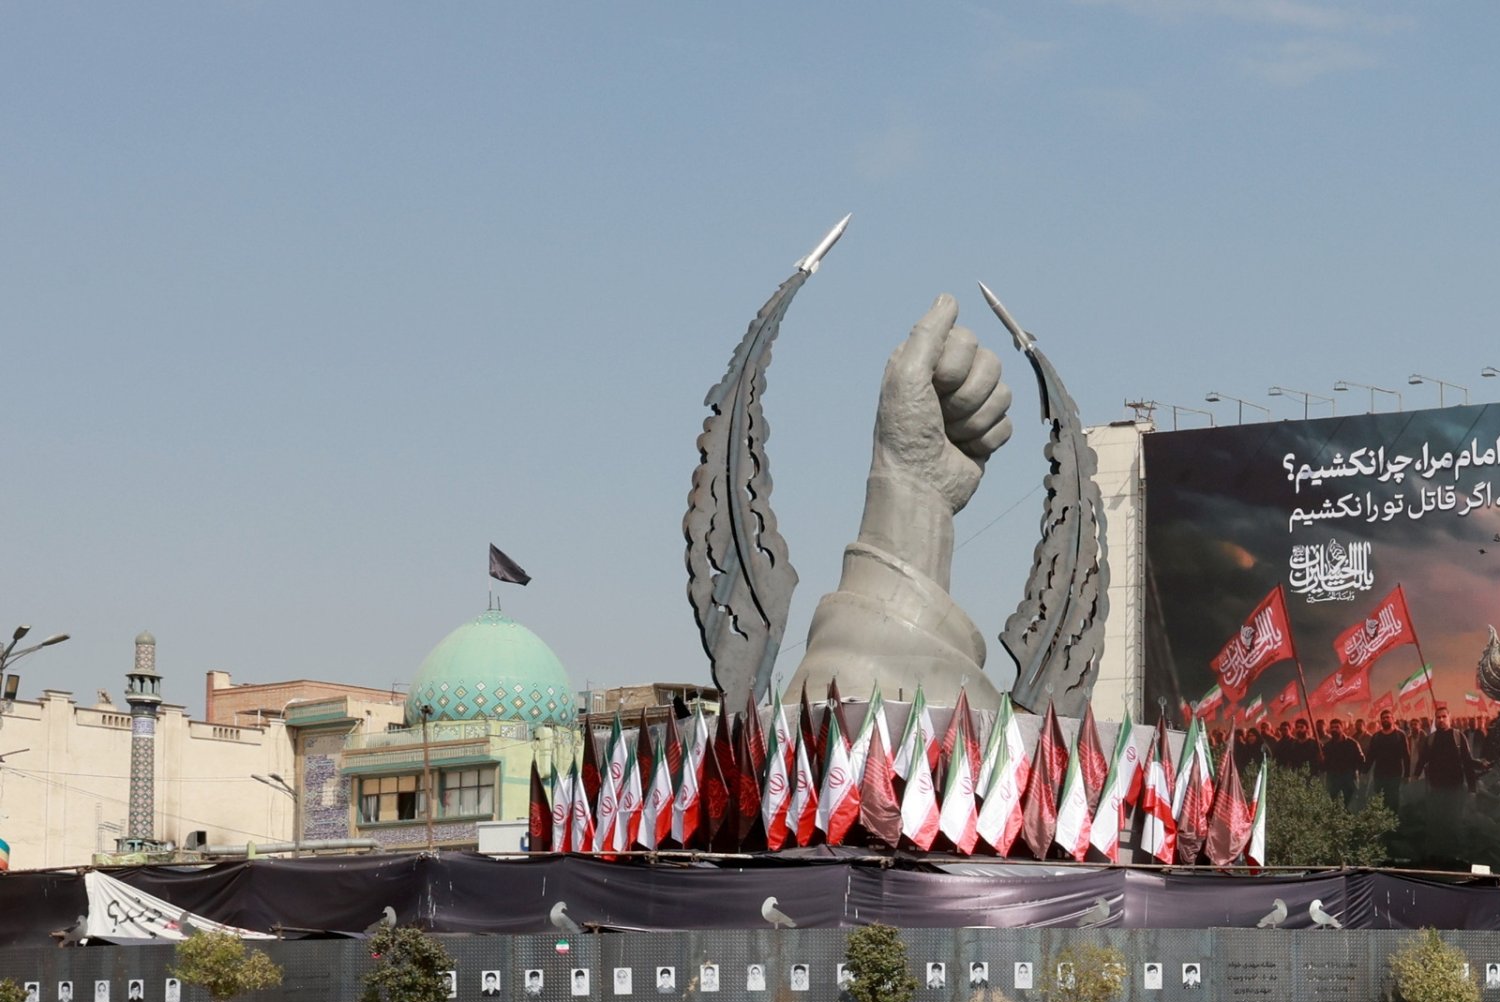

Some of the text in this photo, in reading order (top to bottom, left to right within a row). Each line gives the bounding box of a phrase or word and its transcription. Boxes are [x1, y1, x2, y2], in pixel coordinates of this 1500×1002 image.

[1283, 447, 1376, 494] نکشیم؟
[1378, 446, 1413, 483] چرا
[1415, 441, 1453, 478] مرا،
[1289, 493, 1361, 533] نکشیم
[1366, 491, 1379, 522] را
[1382, 494, 1404, 521] تو
[1408, 485, 1456, 519] قاتل
[1458, 481, 1491, 515] اگر
